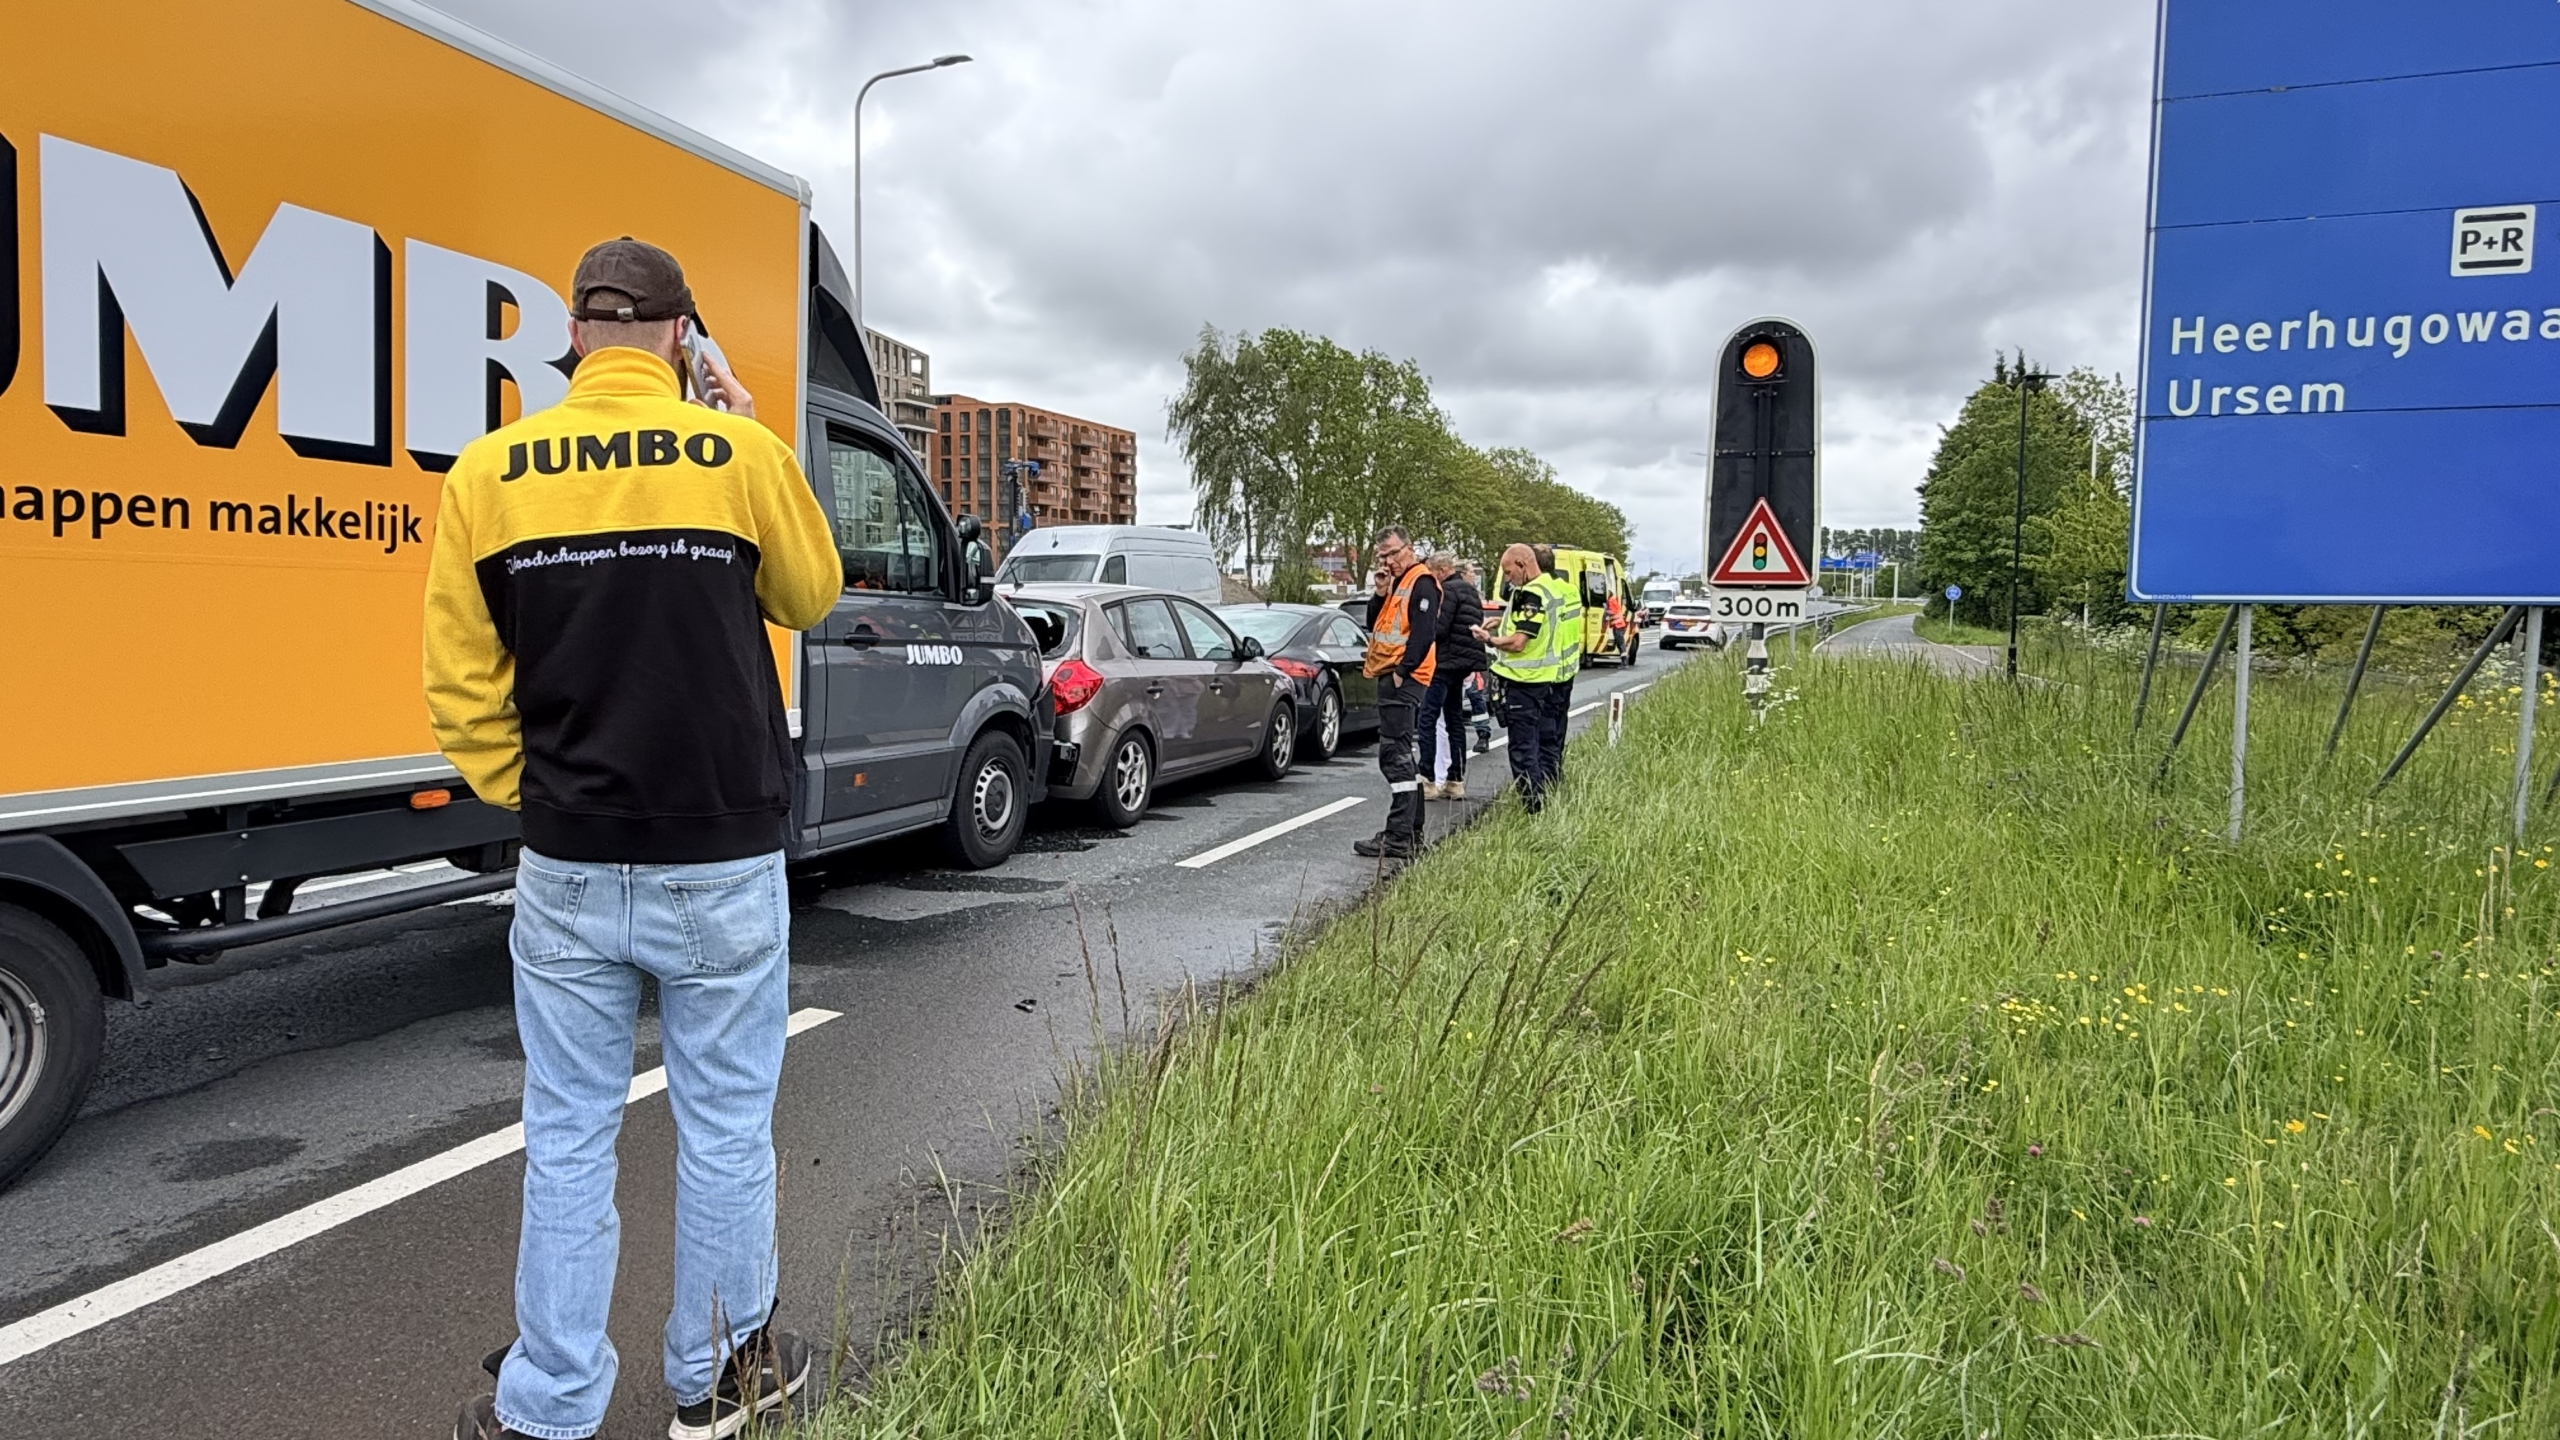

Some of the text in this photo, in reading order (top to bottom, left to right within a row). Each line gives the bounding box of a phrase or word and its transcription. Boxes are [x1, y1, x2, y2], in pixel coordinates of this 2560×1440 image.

[2460, 227, 2524, 255] P+R
[0, 130, 738, 474] MB
[2170, 308, 2560, 359] Heerhugowaa
[2167, 379, 2345, 417] Ursem
[500, 429, 733, 482] JUMBO
[0, 484, 423, 554] appen makkelijk
[620, 541, 668, 559] bezorg
[670, 538, 688, 554] ik
[906, 644, 963, 665] JUMBO
